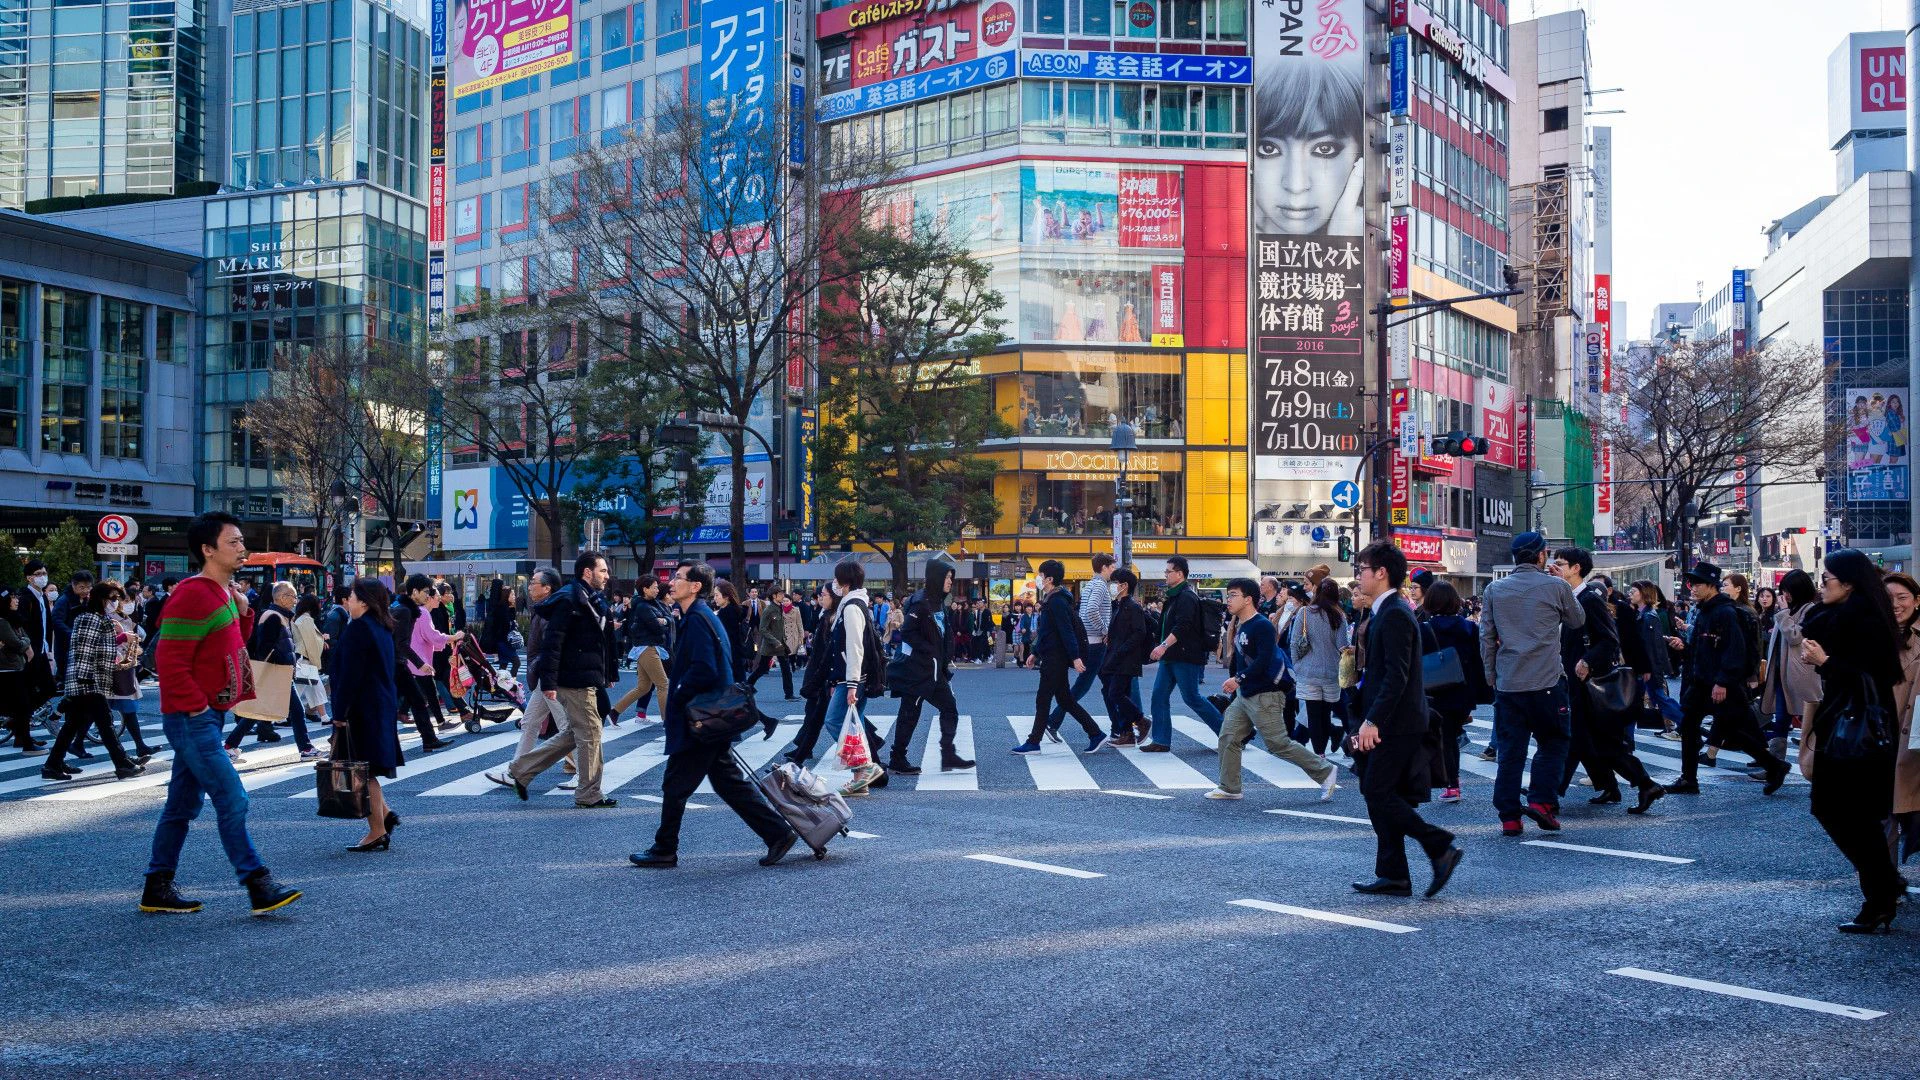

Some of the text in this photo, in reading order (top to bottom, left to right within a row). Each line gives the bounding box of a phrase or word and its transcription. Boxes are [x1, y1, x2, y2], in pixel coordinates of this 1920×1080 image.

[471, 0, 567, 41] クリニッ
[793, 0, 802, 43] ルーム
[985, 20, 1012, 36] ガスト
[857, 43, 890, 66] Café
[892, 22, 971, 75] ガスト
[480, 59, 493, 73] 4F
[823, 55, 849, 82] 7F
[988, 60, 1006, 76] 6F
[1030, 53, 1081, 73] AEON
[1095, 55, 1247, 79] 英会話イーオン
[1869, 55, 1906, 77] UN
[867, 65, 979, 106] 英会話イーオン
[1869, 82, 1906, 108] QL
[700, 15, 738, 208] アイシティ
[745, 7, 765, 203] コンタクトの
[432, 148, 445, 156] 8F
[1394, 133, 1405, 200] 渋谷駅前ビル
[1119, 177, 1158, 197] 沖縄
[1392, 217, 1407, 226] 5F
[251, 238, 317, 253] SHIBUYA
[1259, 240, 1361, 270] 国立代々木
[217, 249, 355, 273] MARK CITY
[253, 284, 271, 293] 渋谷
[1258, 272, 1362, 301] 競技場第一
[1159, 272, 1175, 328] 毎日開催
[1597, 287, 1608, 310] 免税
[1259, 300, 1352, 332] 体育館 3
[1330, 316, 1359, 336] Days!
[1159, 337, 1176, 346] 4F
[1296, 340, 1325, 350] 2016
[1265, 359, 1355, 388] 7月8日(金)
[1265, 390, 1355, 419] 7月9日(土)
[1261, 422, 1359, 451] 7月10日(日)
[1488, 415, 1509, 439] アコム
[1085, 473, 1139, 481] PROVCE
[237, 504, 261, 512] MRK
[1394, 509, 1406, 523] 薬
[1483, 498, 1513, 527] LUSH
[41, 526, 61, 534] MAR
[512, 519, 529, 527] SUMIT
[700, 528, 731, 539] 東急リバブ
